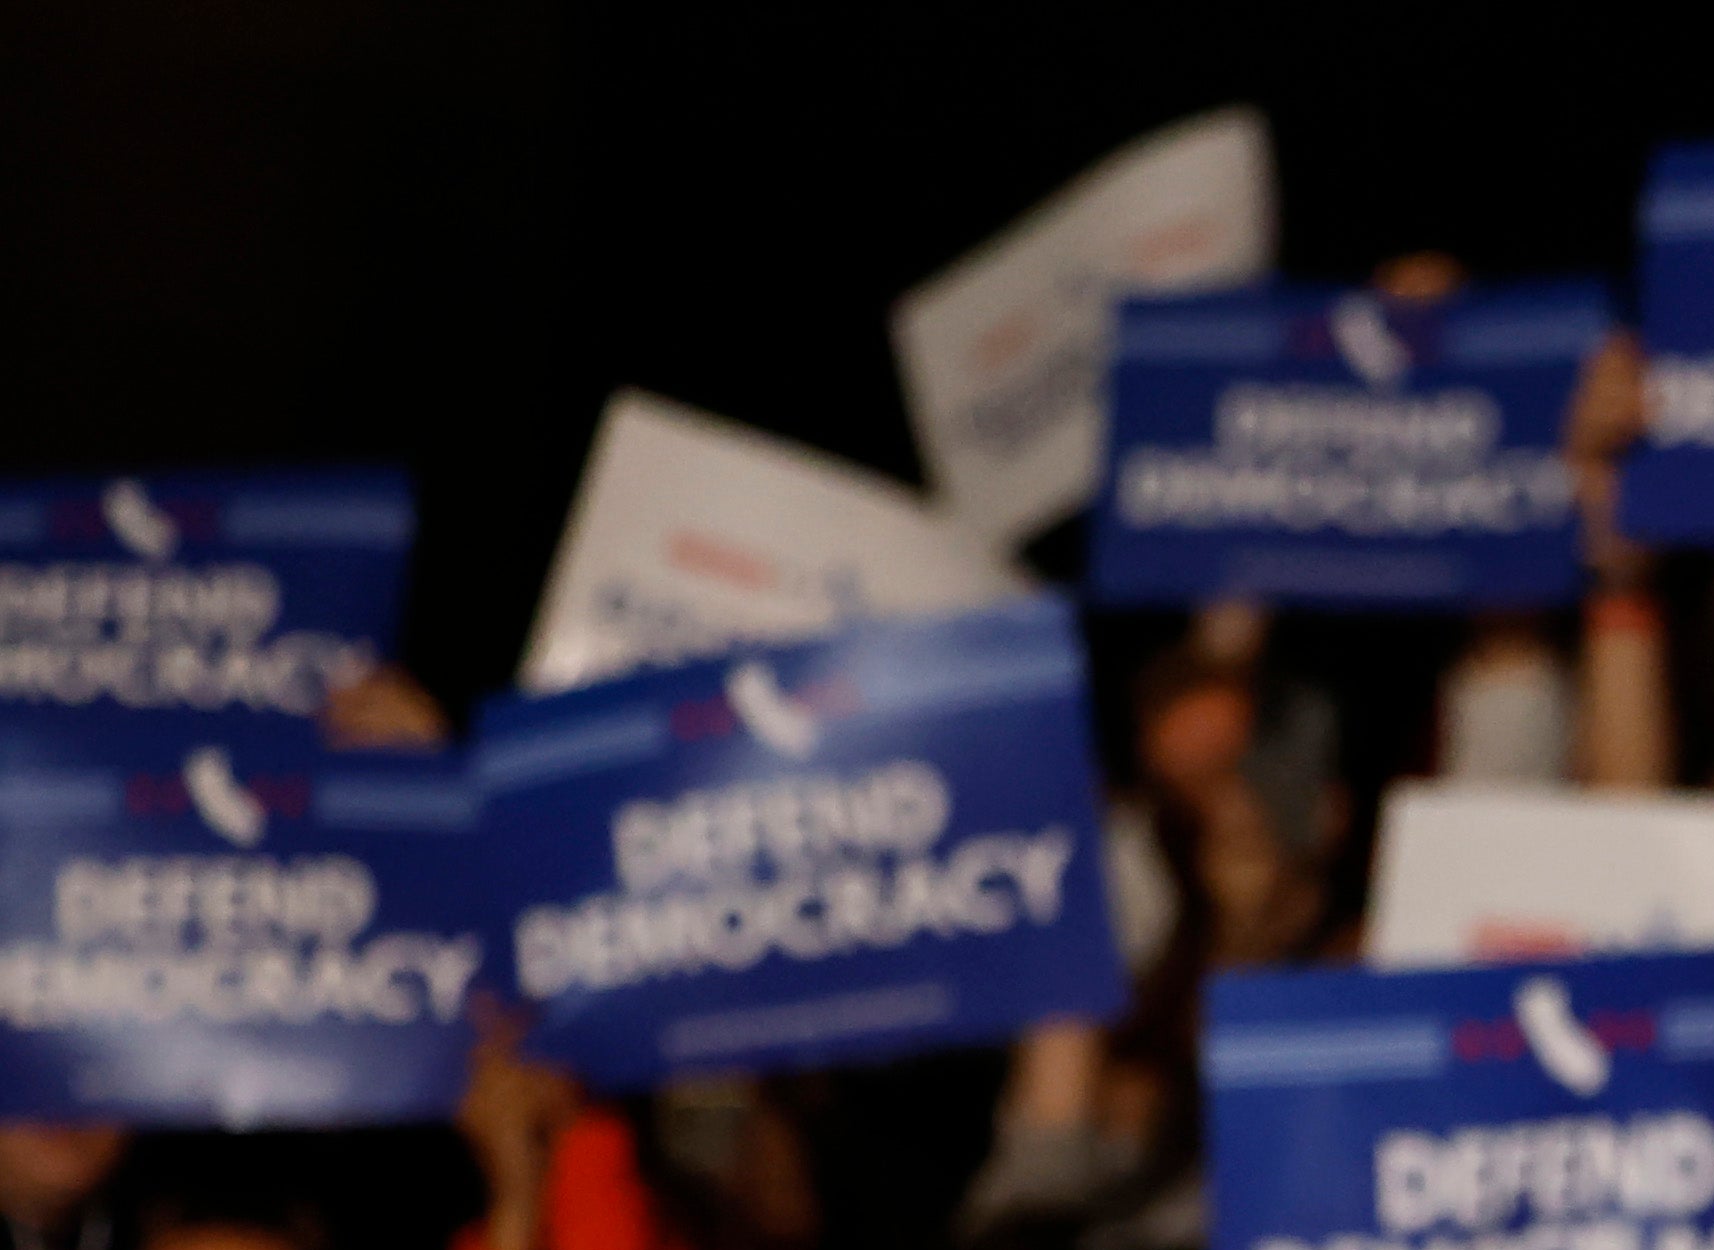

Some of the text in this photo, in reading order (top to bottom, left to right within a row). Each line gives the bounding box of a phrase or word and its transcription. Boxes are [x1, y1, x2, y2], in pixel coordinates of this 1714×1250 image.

[610, 762, 952, 897] DEFEND
[55, 855, 378, 948] DEFEND
[515, 827, 1072, 1000] DEMOCRACY
